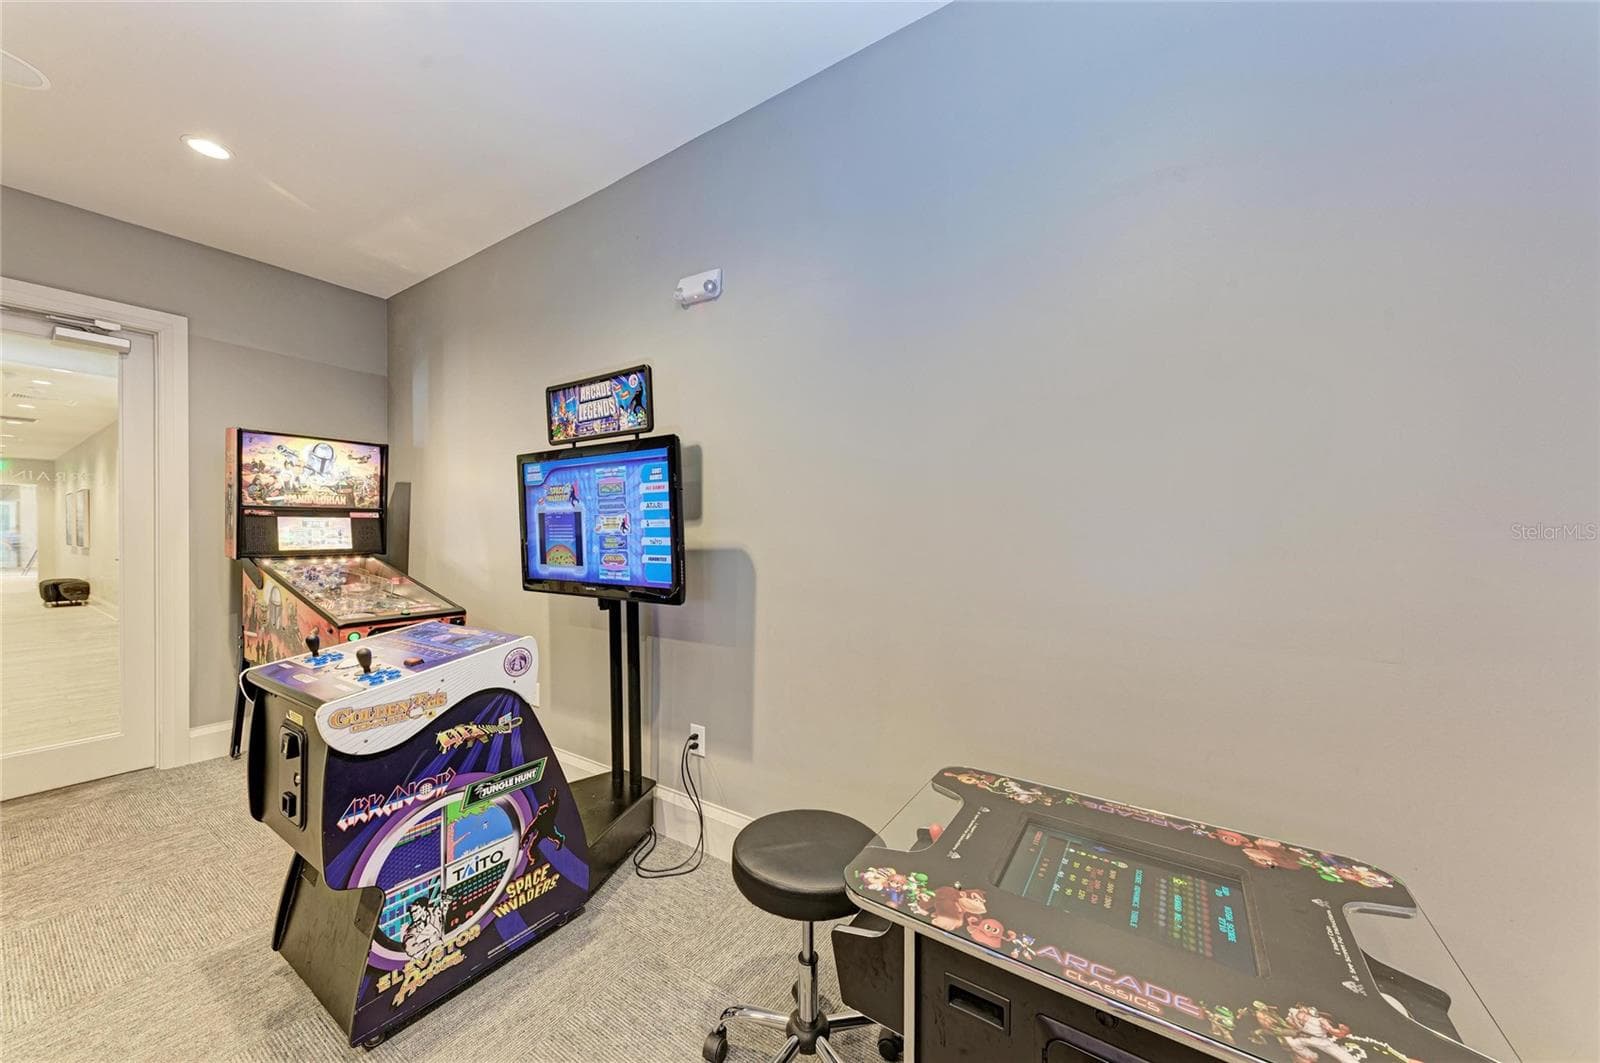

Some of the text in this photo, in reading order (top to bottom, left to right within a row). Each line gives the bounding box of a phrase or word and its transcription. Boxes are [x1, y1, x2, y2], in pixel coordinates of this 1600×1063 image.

[580, 380, 612, 402] ARCADE
[578, 396, 616, 422] LEGENDS
[482, 770, 538, 797] JUNGLE HUNT
[452, 850, 504, 882] TAITO
[506, 863, 551, 898] SPACE
[493, 874, 560, 918] INVADERS
[376, 924, 481, 993] ELEVATOR
[1036, 946, 1206, 1021] ARCADE
[1065, 969, 1163, 1014] CLASSICS
